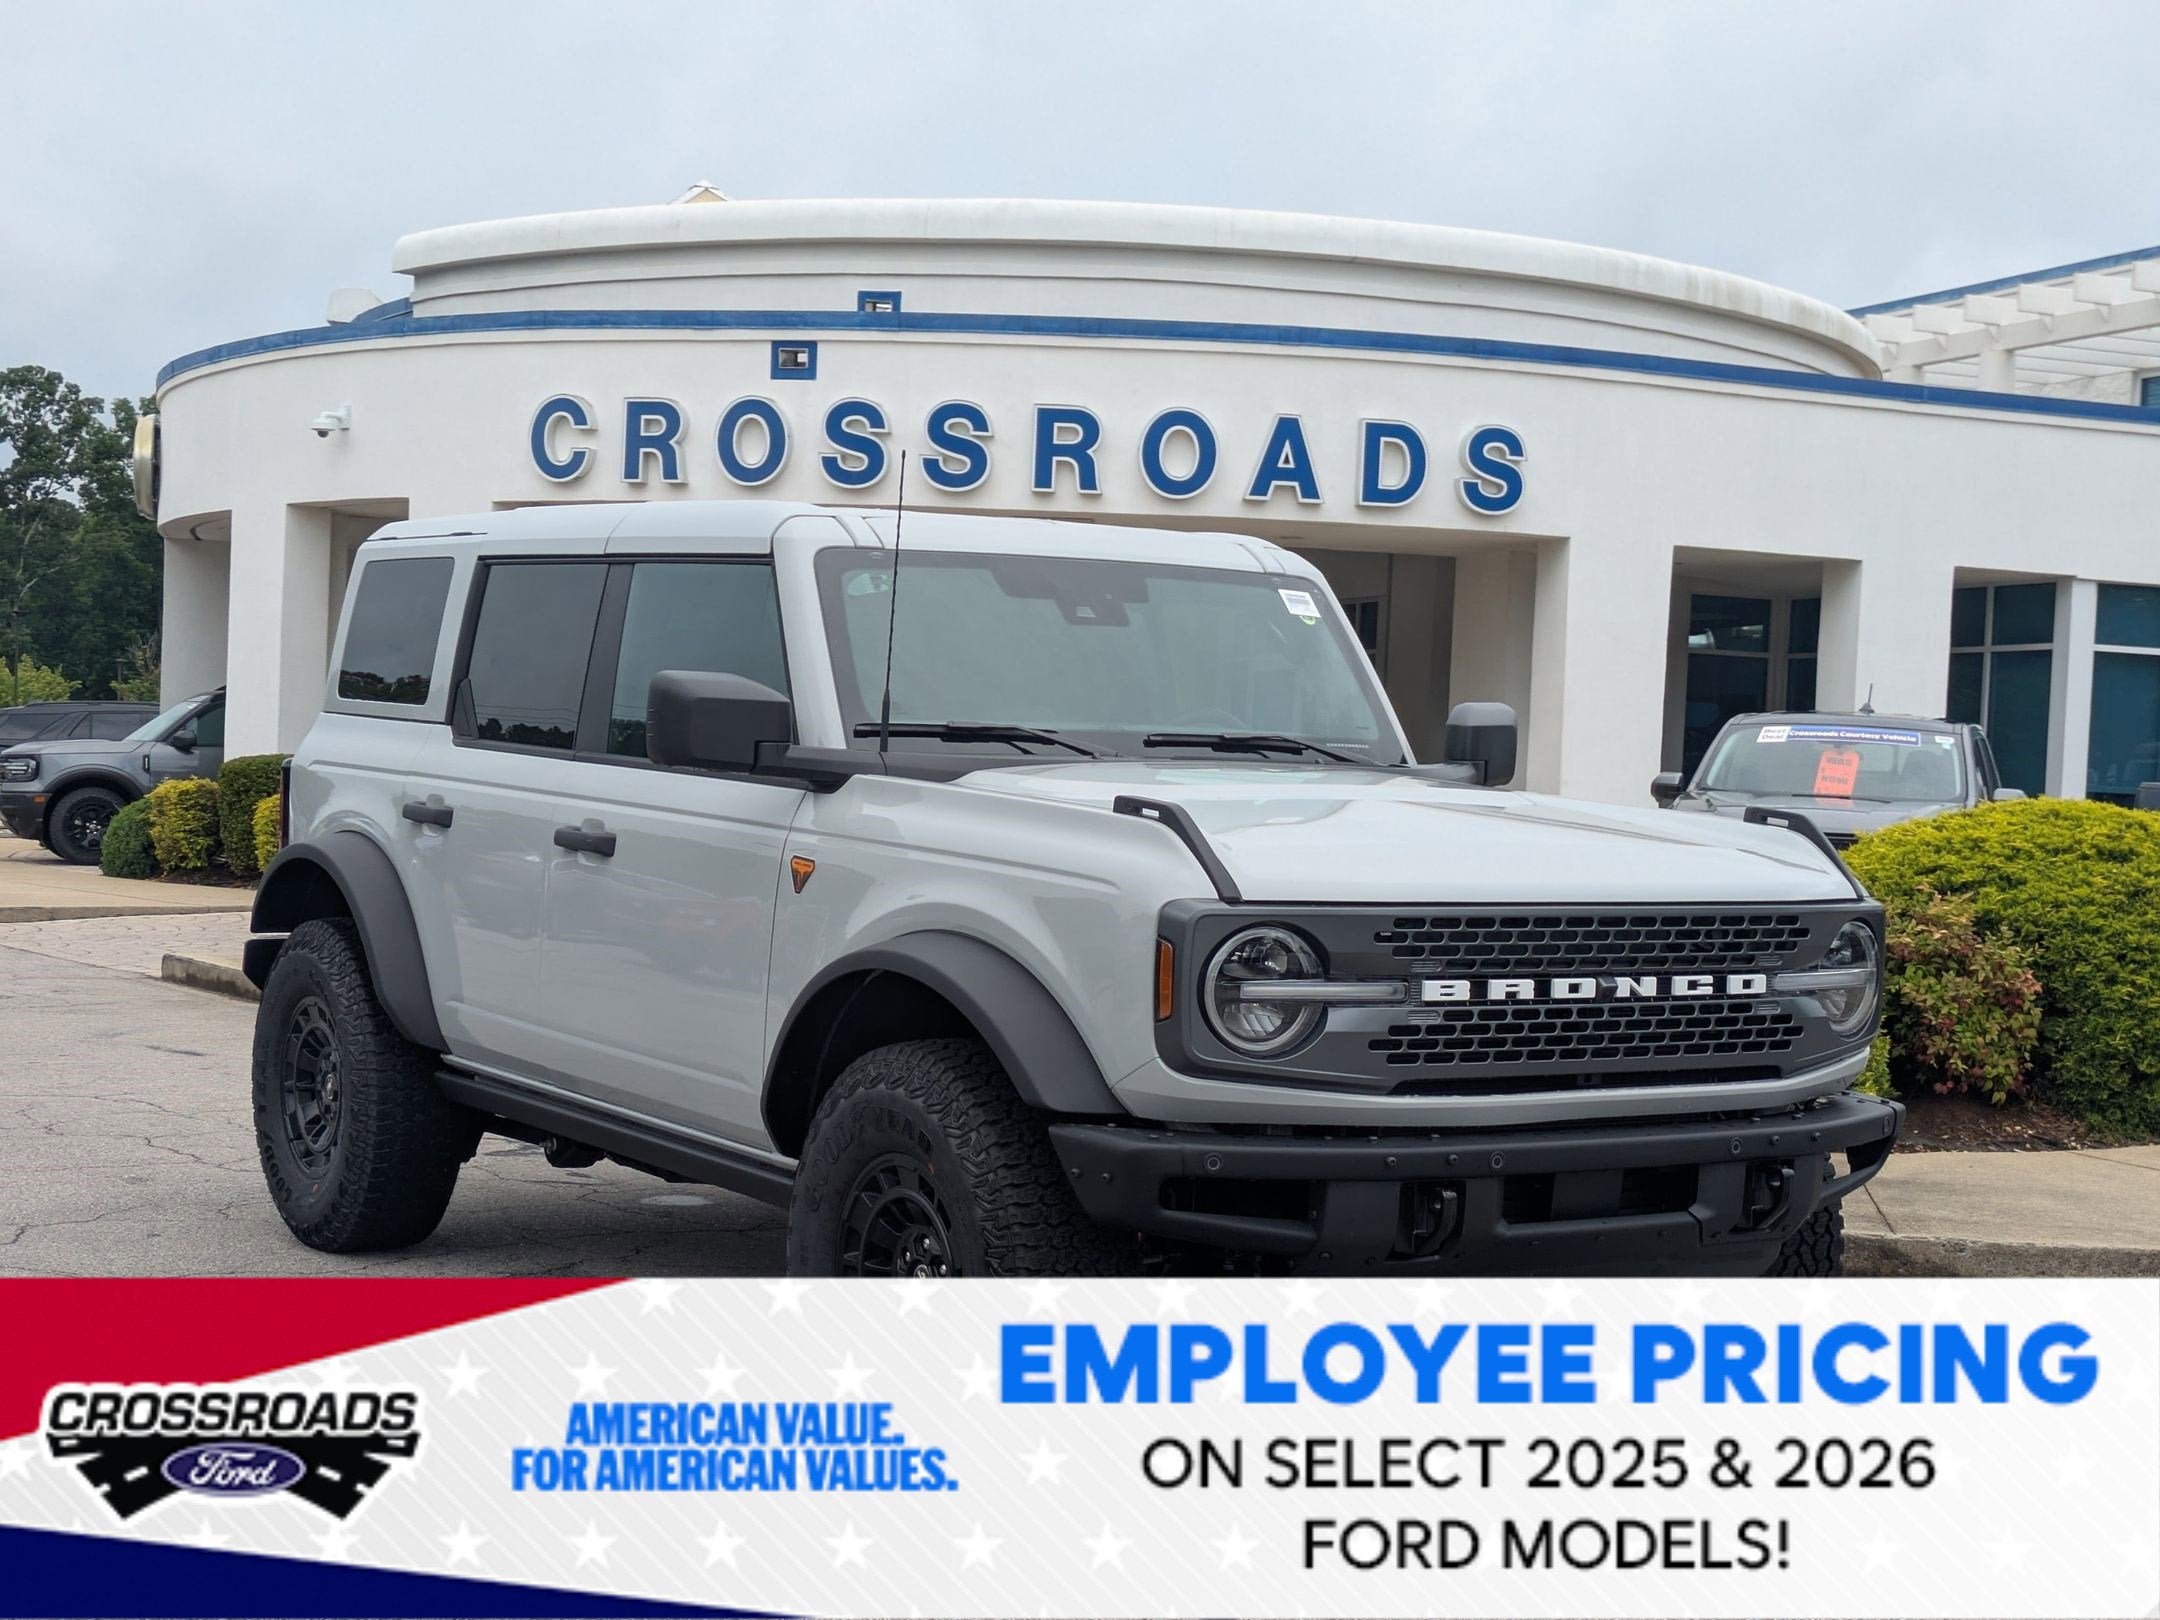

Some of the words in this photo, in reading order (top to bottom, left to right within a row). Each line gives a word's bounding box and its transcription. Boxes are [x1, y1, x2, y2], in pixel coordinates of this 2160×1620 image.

[530, 396, 1528, 516] CROSSROADS
[1789, 729, 1838, 738] Crossroads
[1839, 731, 1880, 740] Courtesy
[1881, 733, 1918, 742] Vehicle
[1421, 974, 1767, 1001] BRONCO
